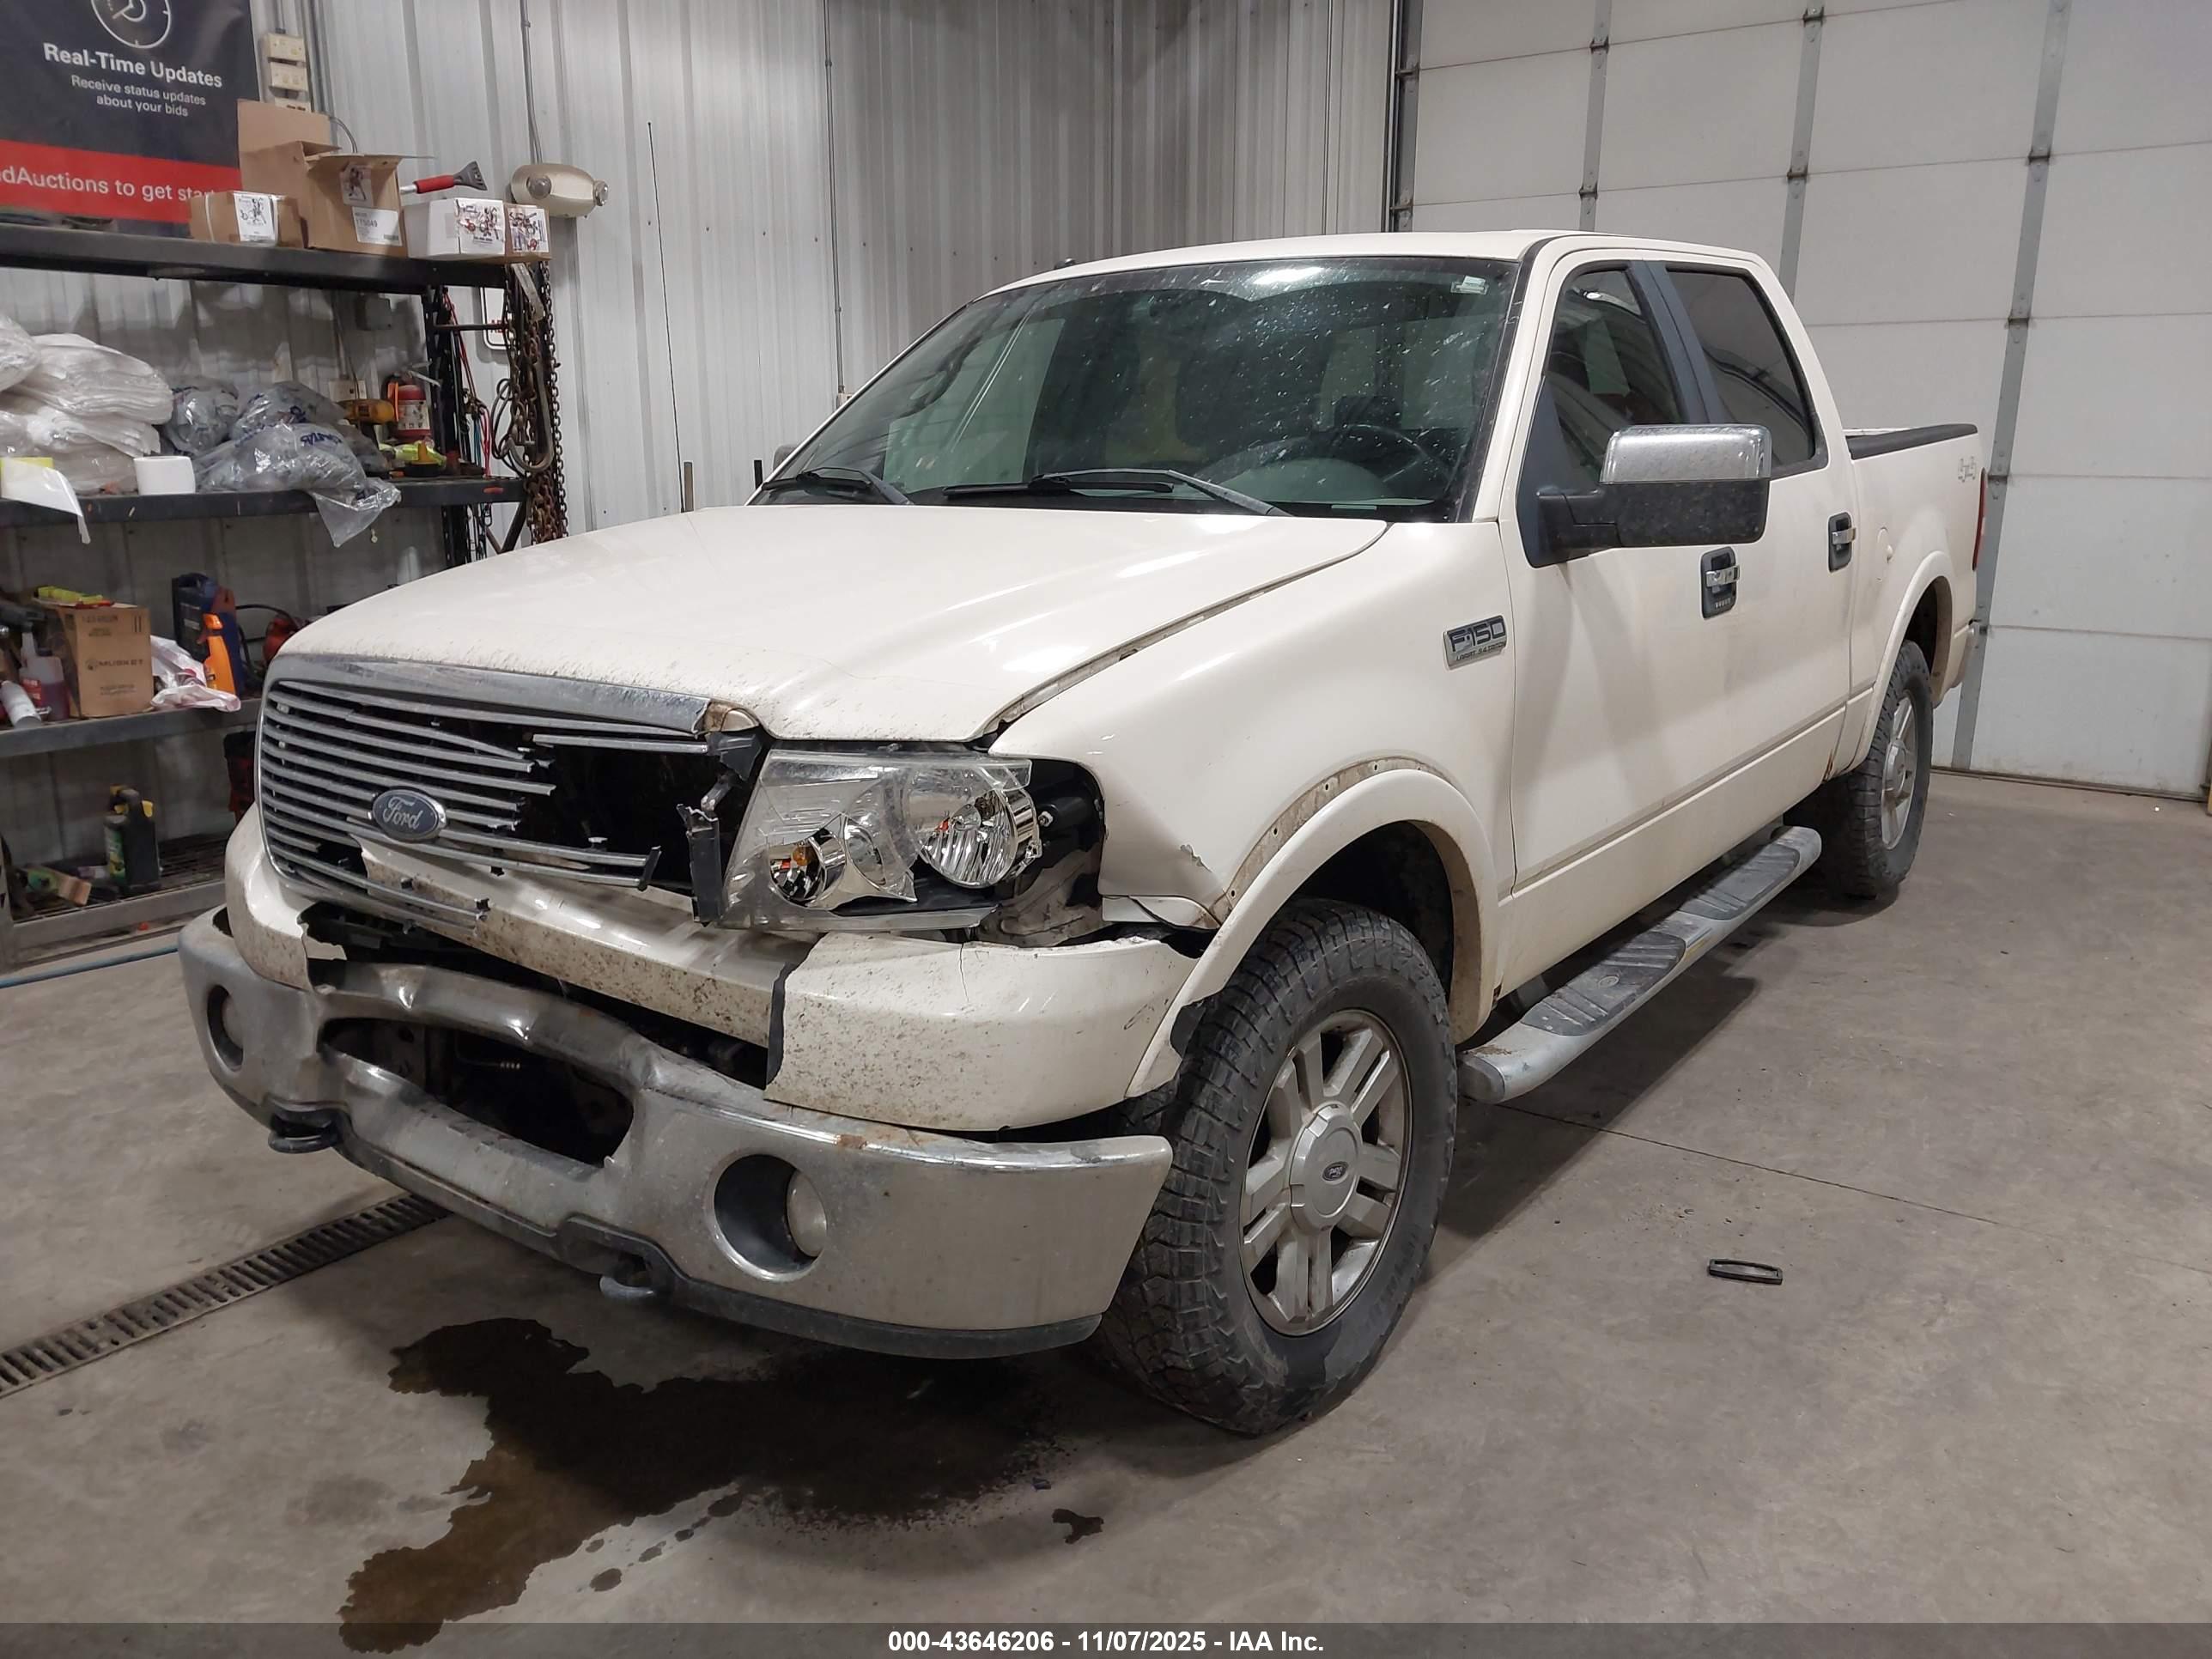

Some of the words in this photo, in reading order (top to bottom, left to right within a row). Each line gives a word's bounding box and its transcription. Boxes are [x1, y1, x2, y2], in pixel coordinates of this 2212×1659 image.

[44, 42, 146, 76] Real-Time
[149, 61, 223, 88] Updates
[71, 75, 122, 94] Receive
[124, 83, 160, 100] status
[162, 89, 207, 106] updates
[96, 94, 132, 109] about
[135, 100, 162, 113] your
[165, 103, 189, 117] bids
[0, 166, 109, 194] dAuctions
[115, 179, 135, 196] to
[142, 184, 173, 202] get
[382, 796, 424, 830] Ford
